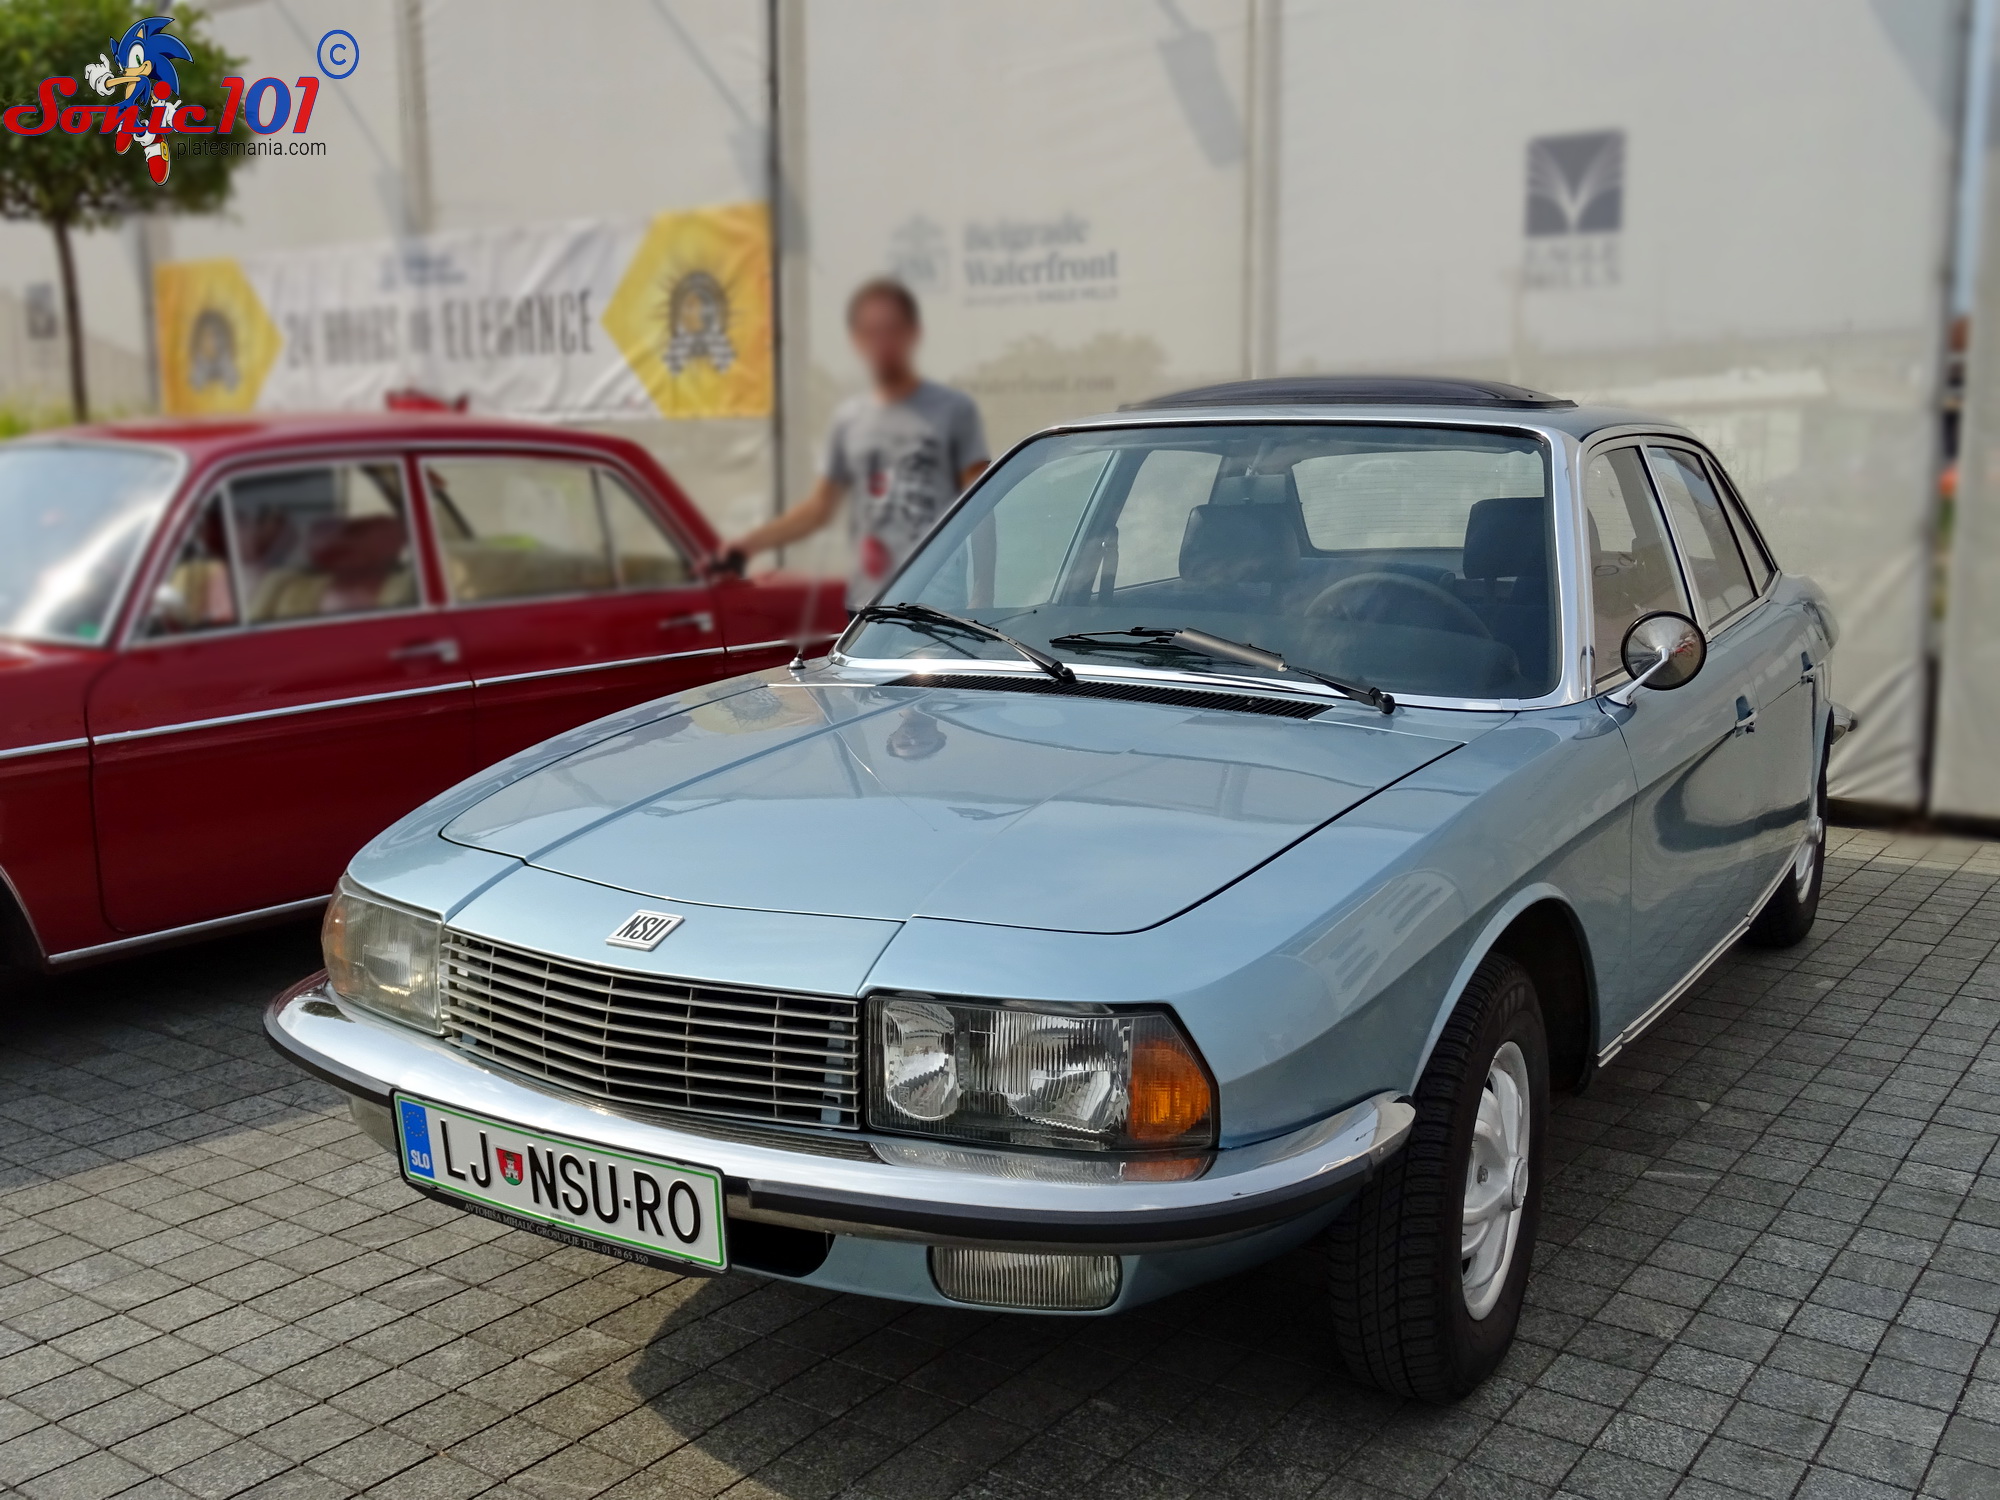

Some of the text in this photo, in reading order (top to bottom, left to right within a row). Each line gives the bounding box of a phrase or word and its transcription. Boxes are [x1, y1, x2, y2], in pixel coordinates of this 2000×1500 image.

[963, 215, 1090, 252] Belgrade
[962, 249, 1118, 287] Waterfront
[442, 288, 593, 361] ELEGANCE
[616, 914, 672, 942] NSU
[410, 1149, 431, 1170] SLO
[440, 1118, 492, 1188] LJ
[535, 1226, 580, 1246] GROSUPLJE
[601, 1244, 611, 1255] 01
[613, 1247, 623, 1258] 78
[623, 1250, 633, 1261] 65
[634, 1252, 649, 1264] 350
